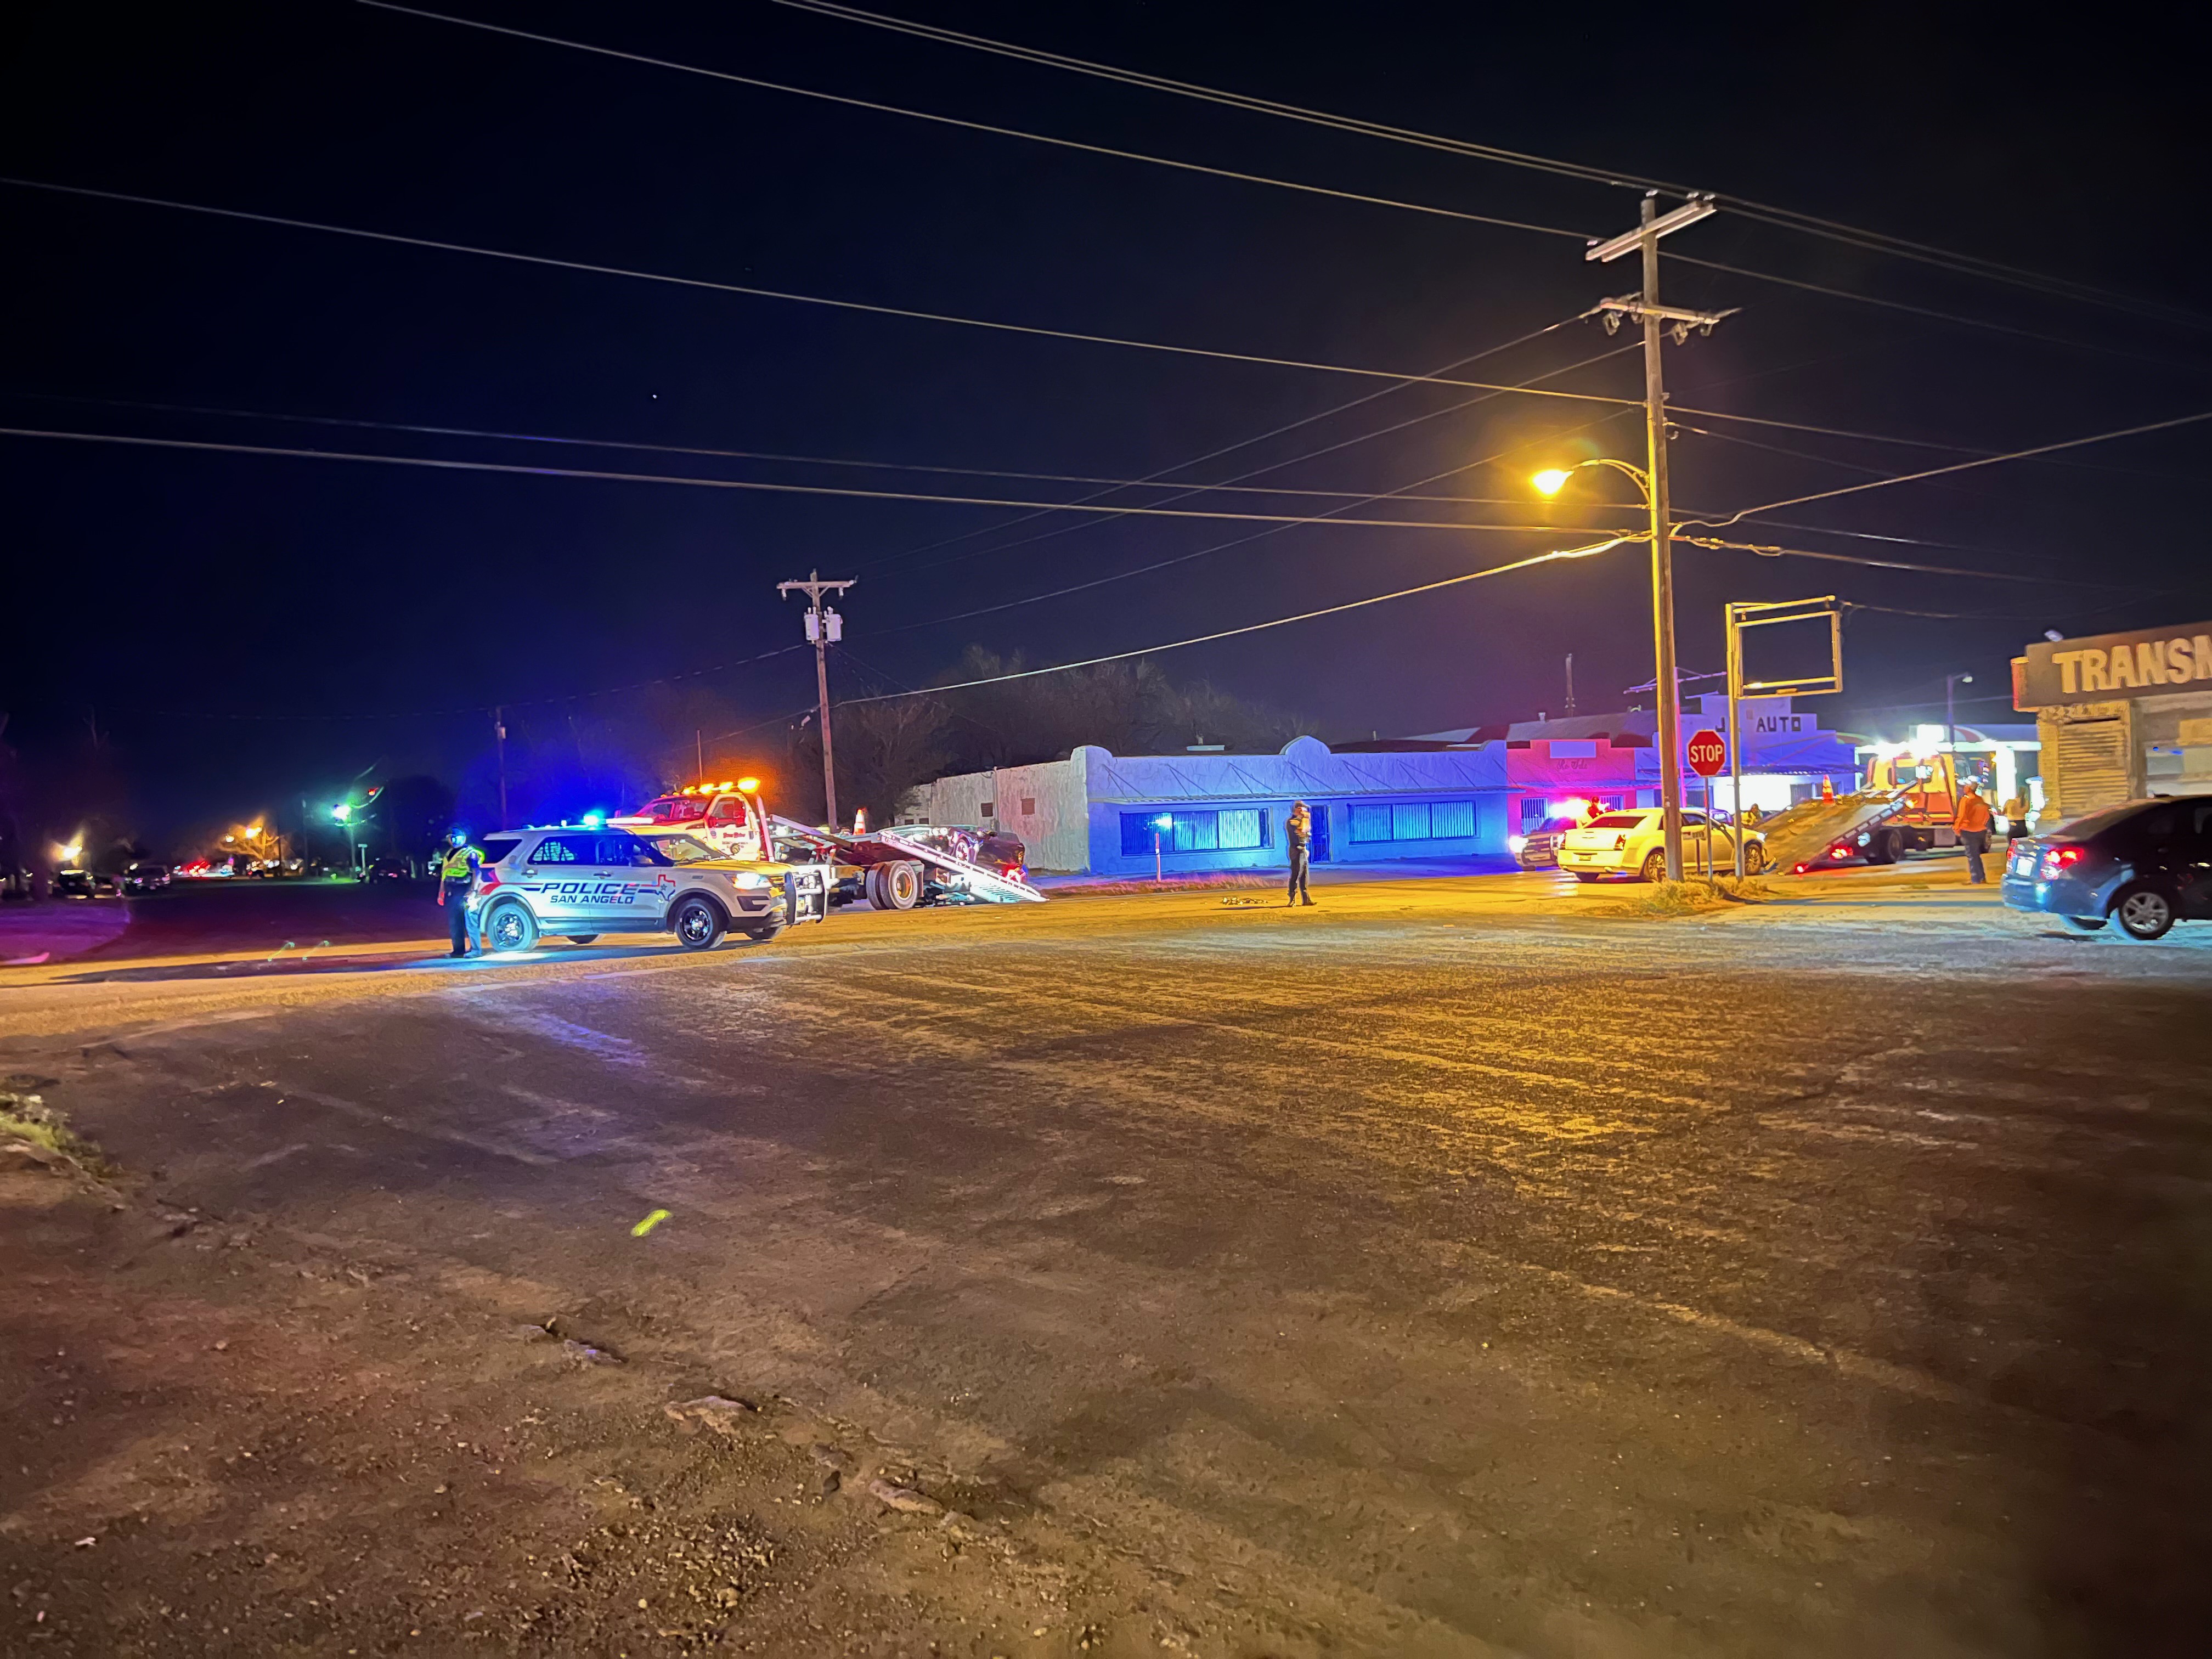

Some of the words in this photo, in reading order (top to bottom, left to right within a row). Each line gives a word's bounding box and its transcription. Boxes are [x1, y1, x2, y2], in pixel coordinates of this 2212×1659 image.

[1756, 716, 1801, 732] AUTO
[1690, 744, 1723, 763] STOP
[540, 882, 640, 895] POLICE
[550, 895, 578, 903] SAN
[579, 895, 634, 904] ANGELO
